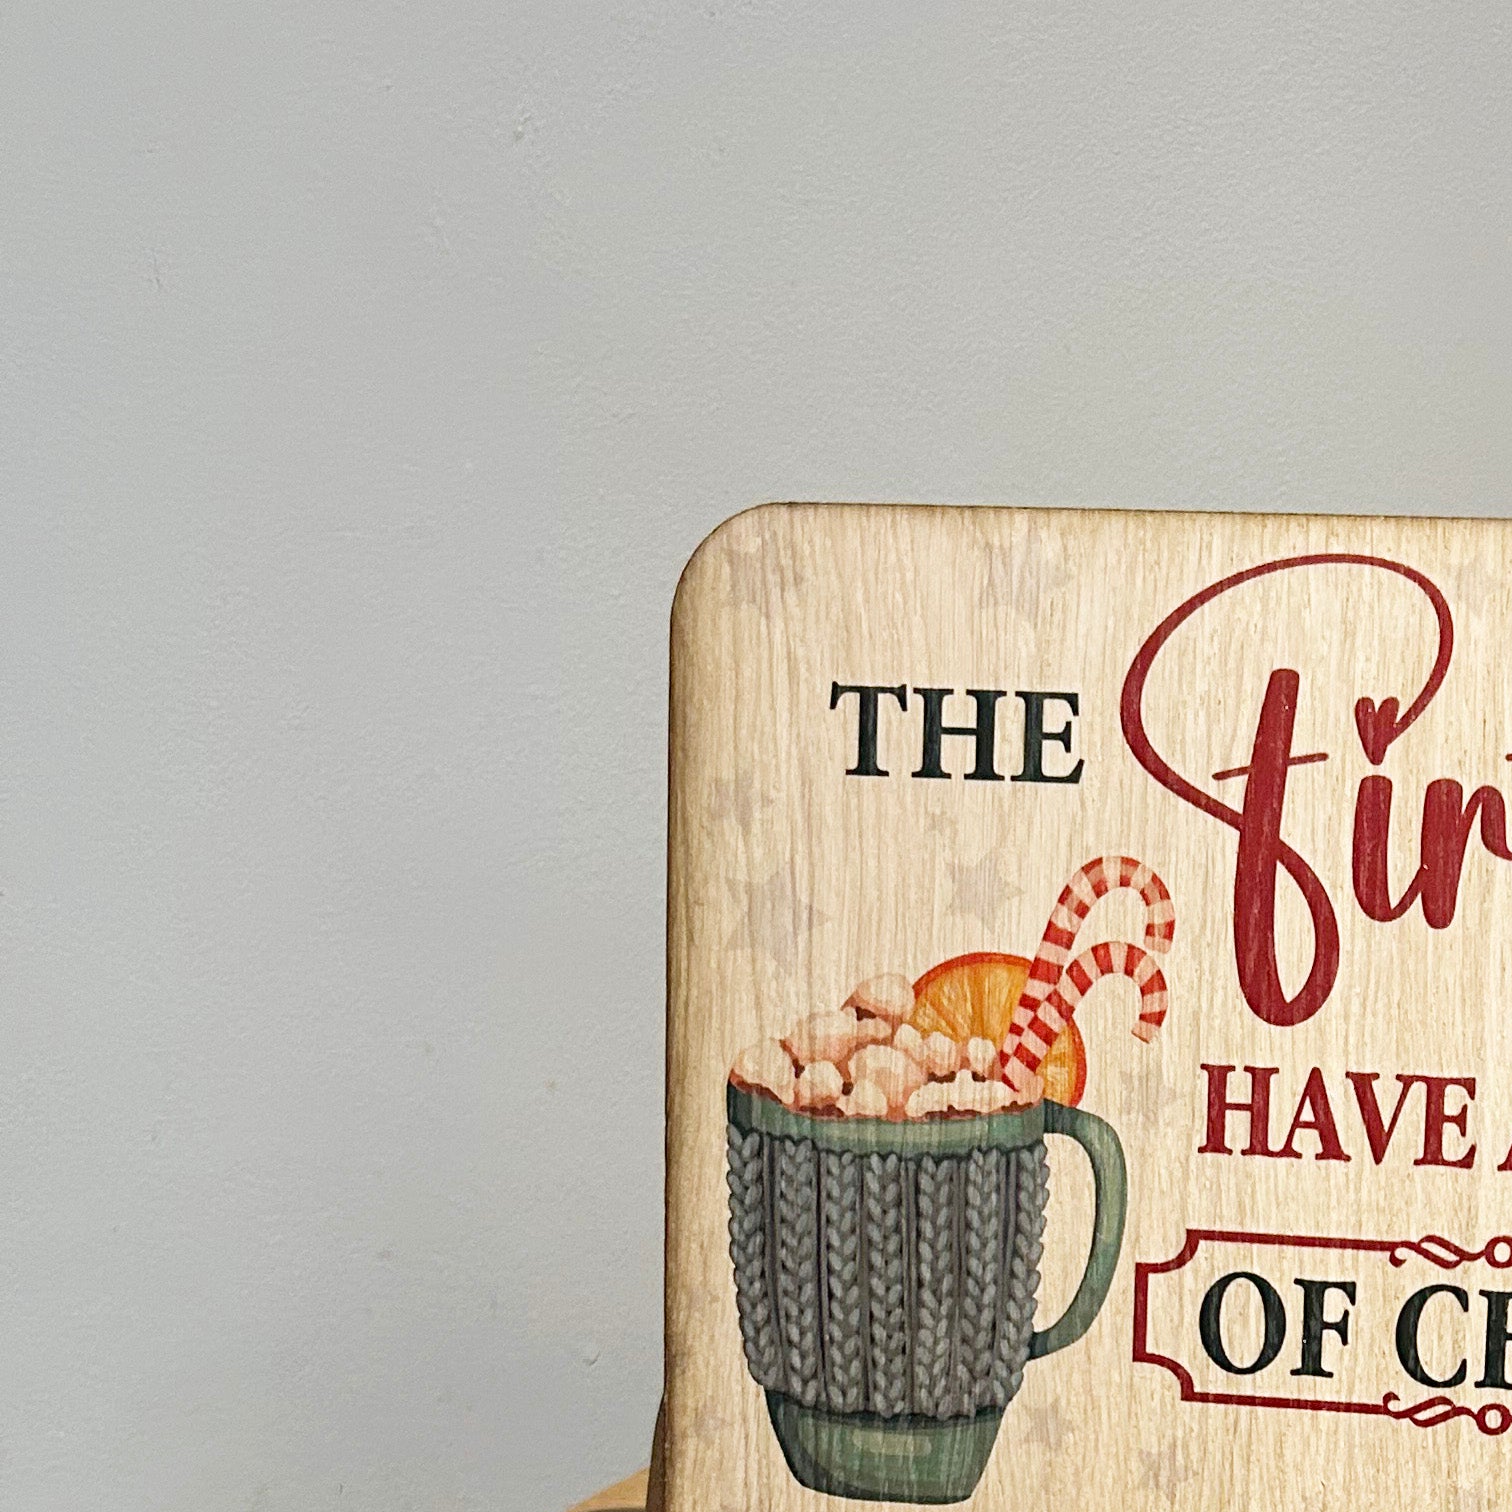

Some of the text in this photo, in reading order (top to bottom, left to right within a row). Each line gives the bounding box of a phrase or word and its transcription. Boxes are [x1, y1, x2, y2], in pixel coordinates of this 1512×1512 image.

[830, 680, 1085, 785] THE
[1198, 1062, 1477, 1170] HAVE
[1199, 1271, 1357, 1379] OF
